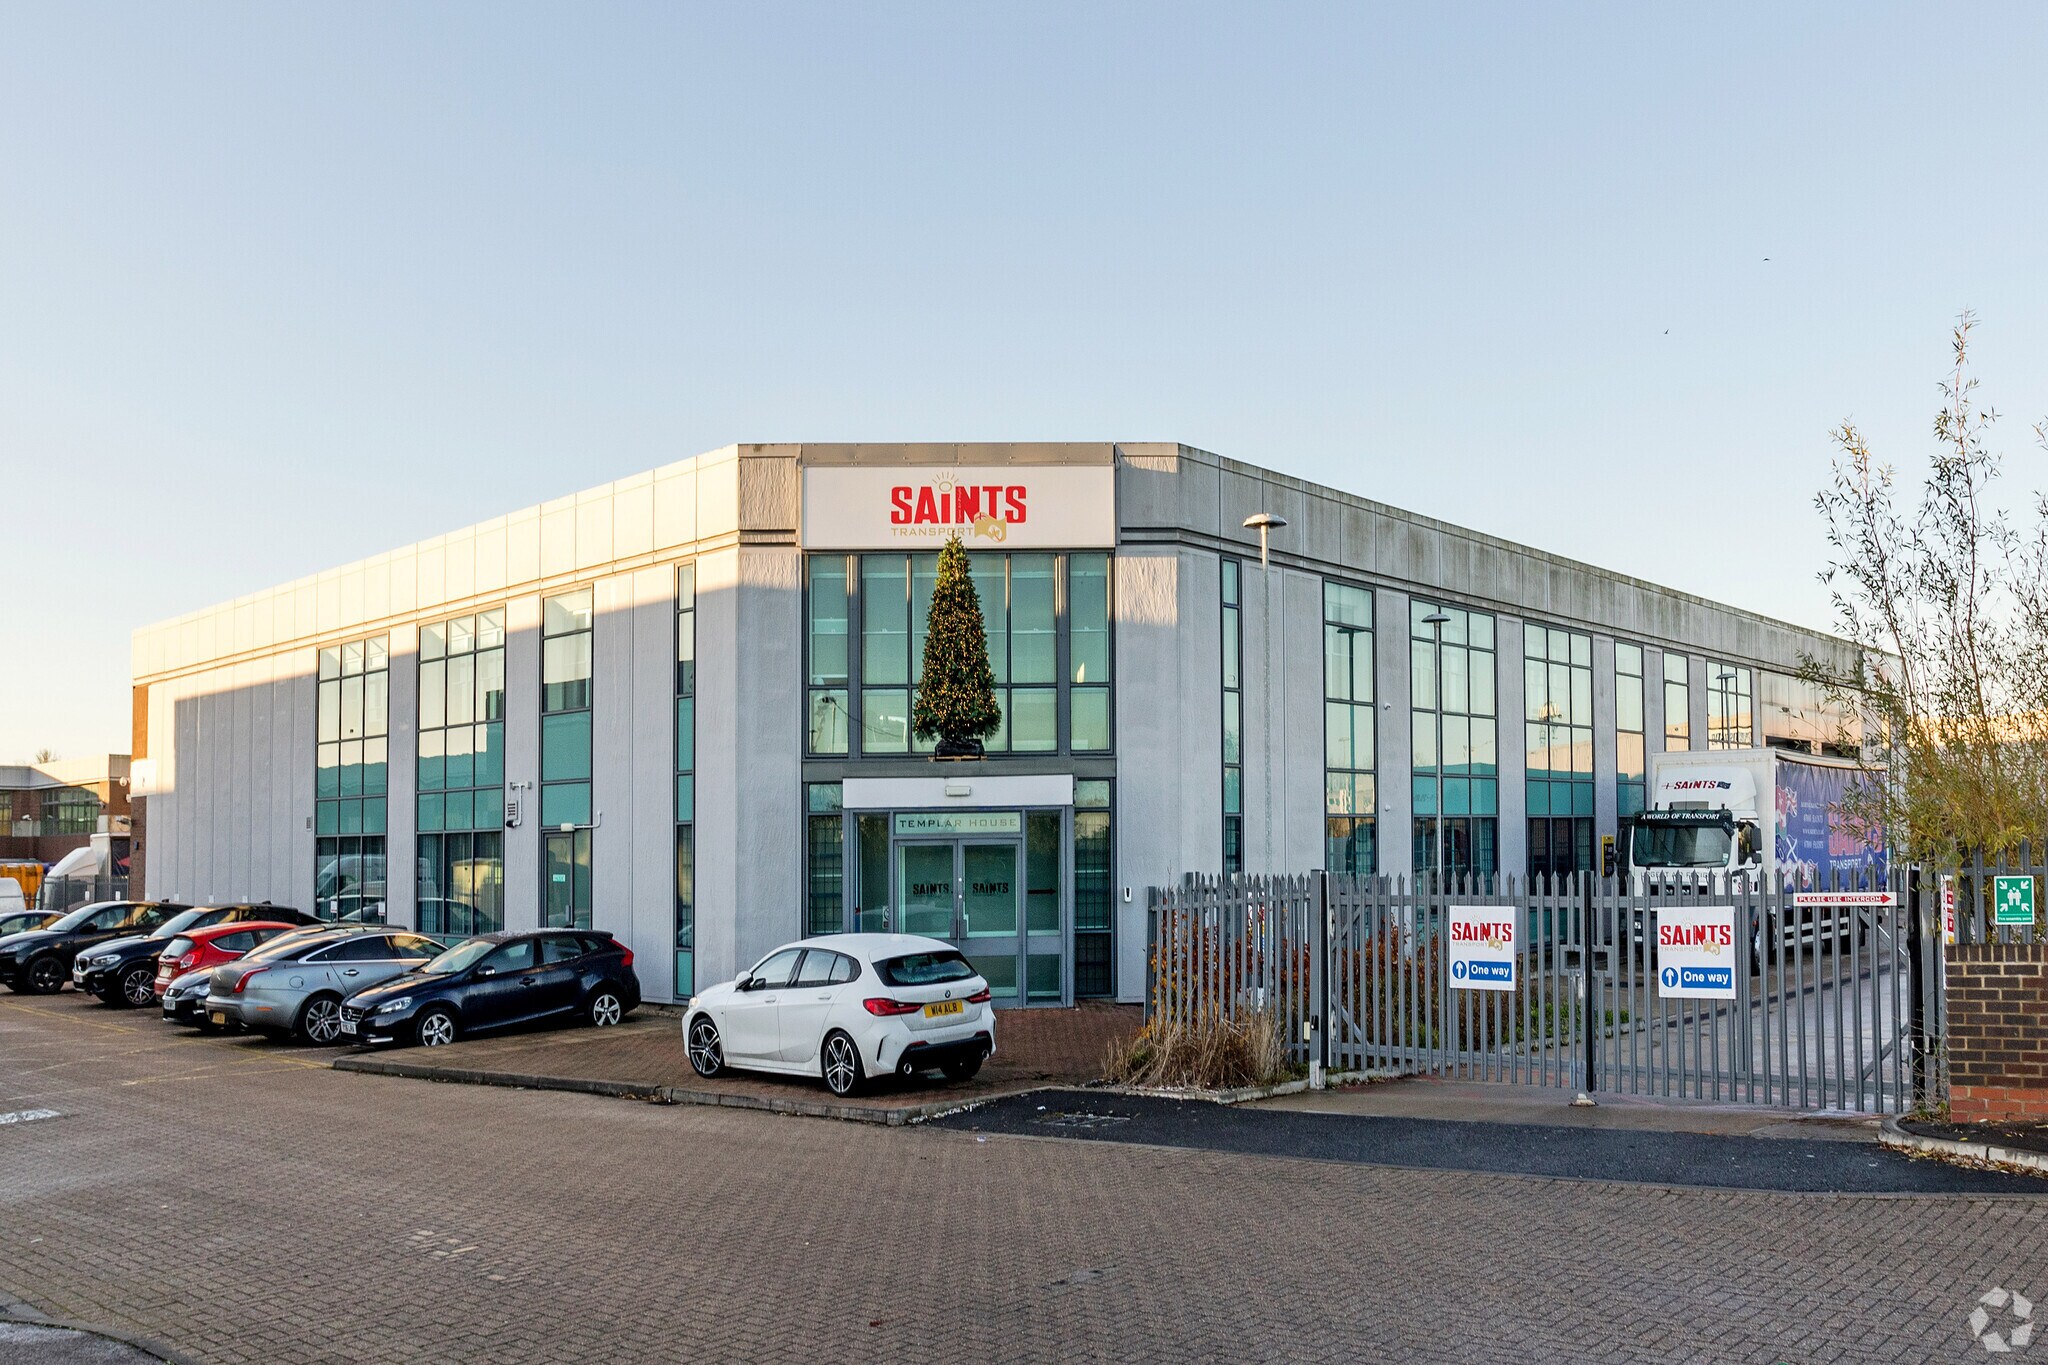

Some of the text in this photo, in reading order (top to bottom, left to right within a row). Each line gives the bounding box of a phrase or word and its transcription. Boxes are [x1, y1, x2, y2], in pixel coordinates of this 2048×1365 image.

[890, 527, 974, 537] TRANSPORT
[1681, 812, 1720, 820] TRANSPORT
[899, 818, 1017, 828] TEMPLAR HOUSE
[1829, 858, 1862, 870] TRANSPORT
[1470, 964, 1509, 978] One way
[1683, 971, 1729, 986] One way
